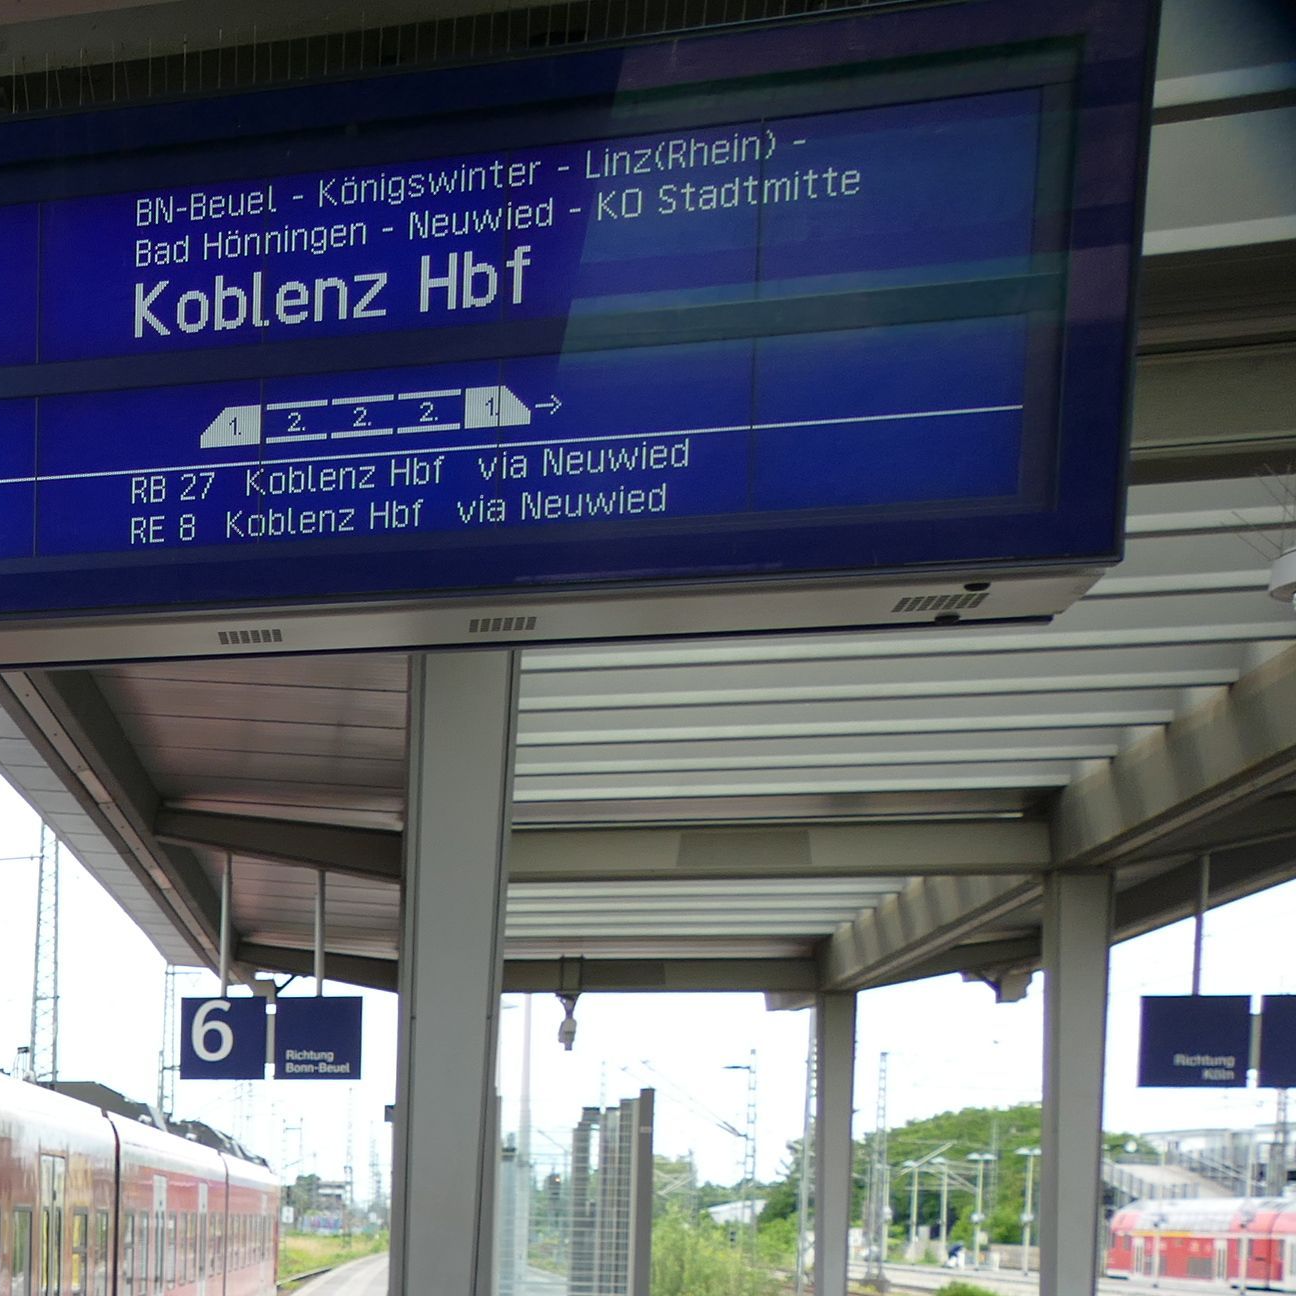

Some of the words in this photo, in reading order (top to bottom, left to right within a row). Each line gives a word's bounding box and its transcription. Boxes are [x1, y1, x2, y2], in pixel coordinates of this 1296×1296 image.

[136, 186, 277, 227] BN-Beuel
[319, 160, 542, 208] Königswinter
[586, 130, 775, 179] Linz(Rhein)
[135, 236, 189, 267] Bad
[203, 222, 367, 261] Hönningen
[408, 197, 553, 240] Neuwied
[597, 188, 642, 221] KO
[658, 167, 860, 214] Stadtmitte
[134, 271, 388, 338] Koblenz
[419, 245, 531, 313] Hbf
[131, 475, 168, 504] RB
[180, 472, 215, 502] 27
[245, 464, 376, 498] Koblenz
[390, 455, 446, 487] Hbf
[477, 452, 527, 481] via
[542, 438, 689, 476] Neuwied
[131, 515, 165, 545] RE
[179, 513, 196, 541] 8
[226, 507, 355, 539] Koblenz
[370, 498, 424, 530] Hbf
[457, 494, 506, 524] via
[521, 482, 667, 520] Neuwied
[191, 1000, 234, 1062] 6
[285, 1050, 335, 1063] Richtung
[1173, 1053, 1236, 1068] Richtung
[285, 1063, 350, 1074] Bonn-Beuel
